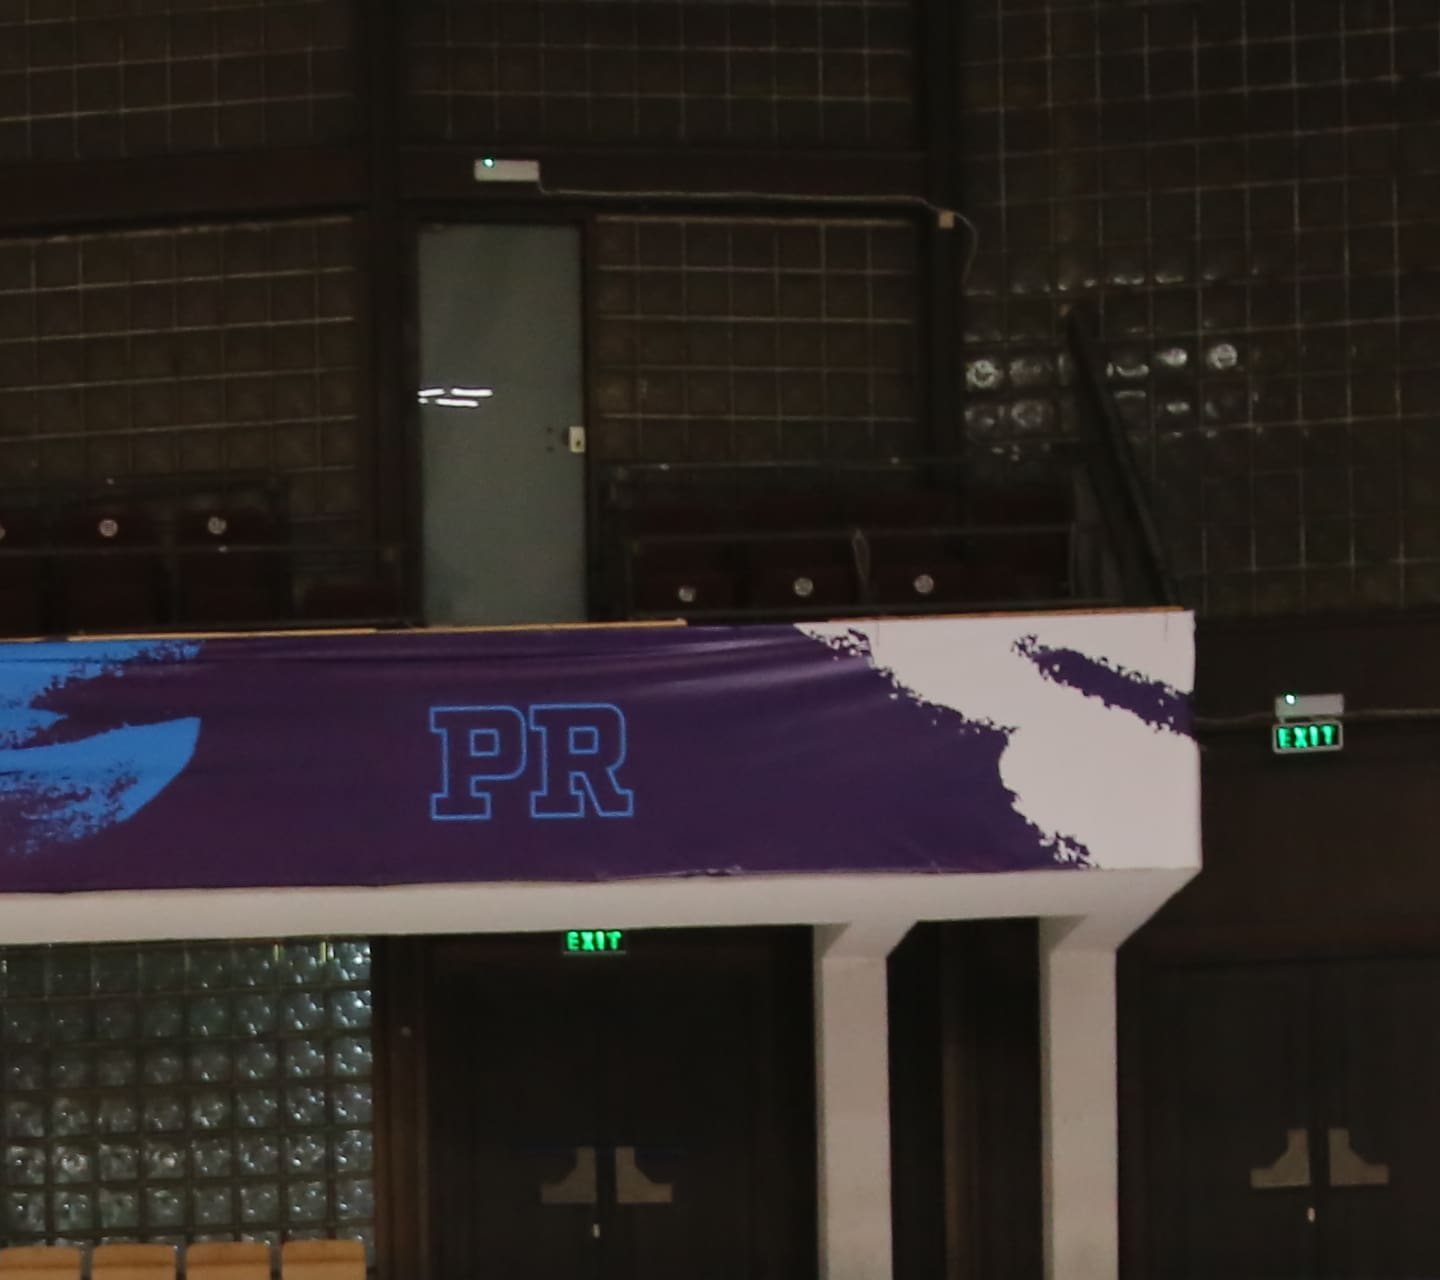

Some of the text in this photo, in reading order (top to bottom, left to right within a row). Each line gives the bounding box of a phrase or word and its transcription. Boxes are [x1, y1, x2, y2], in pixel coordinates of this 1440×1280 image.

[1278, 725, 1334, 749] EXIT
[429, 703, 634, 821] PR
[566, 930, 623, 951] EXIT
